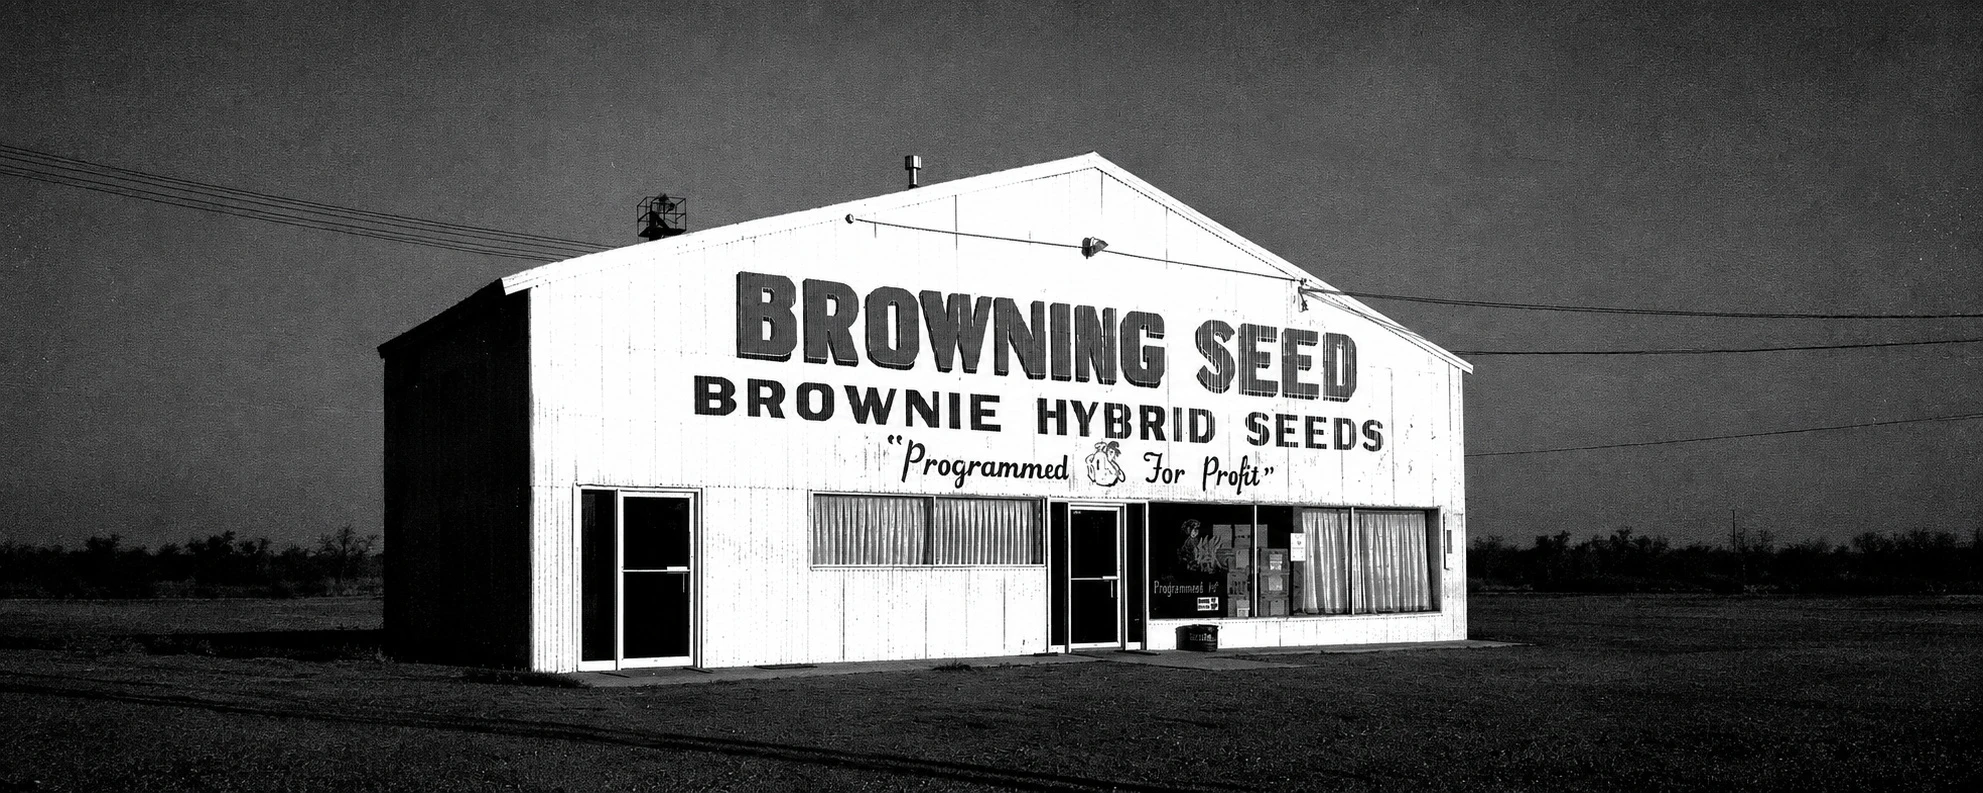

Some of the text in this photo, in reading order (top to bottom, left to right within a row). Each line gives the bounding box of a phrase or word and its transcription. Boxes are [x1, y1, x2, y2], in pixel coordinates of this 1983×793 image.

[736, 271, 1357, 402] BROWNING SEED
[694, 375, 1384, 452] BROWNIE HYBRID SEEDS
[887, 434, 1275, 495] “Programmed For Profit”
